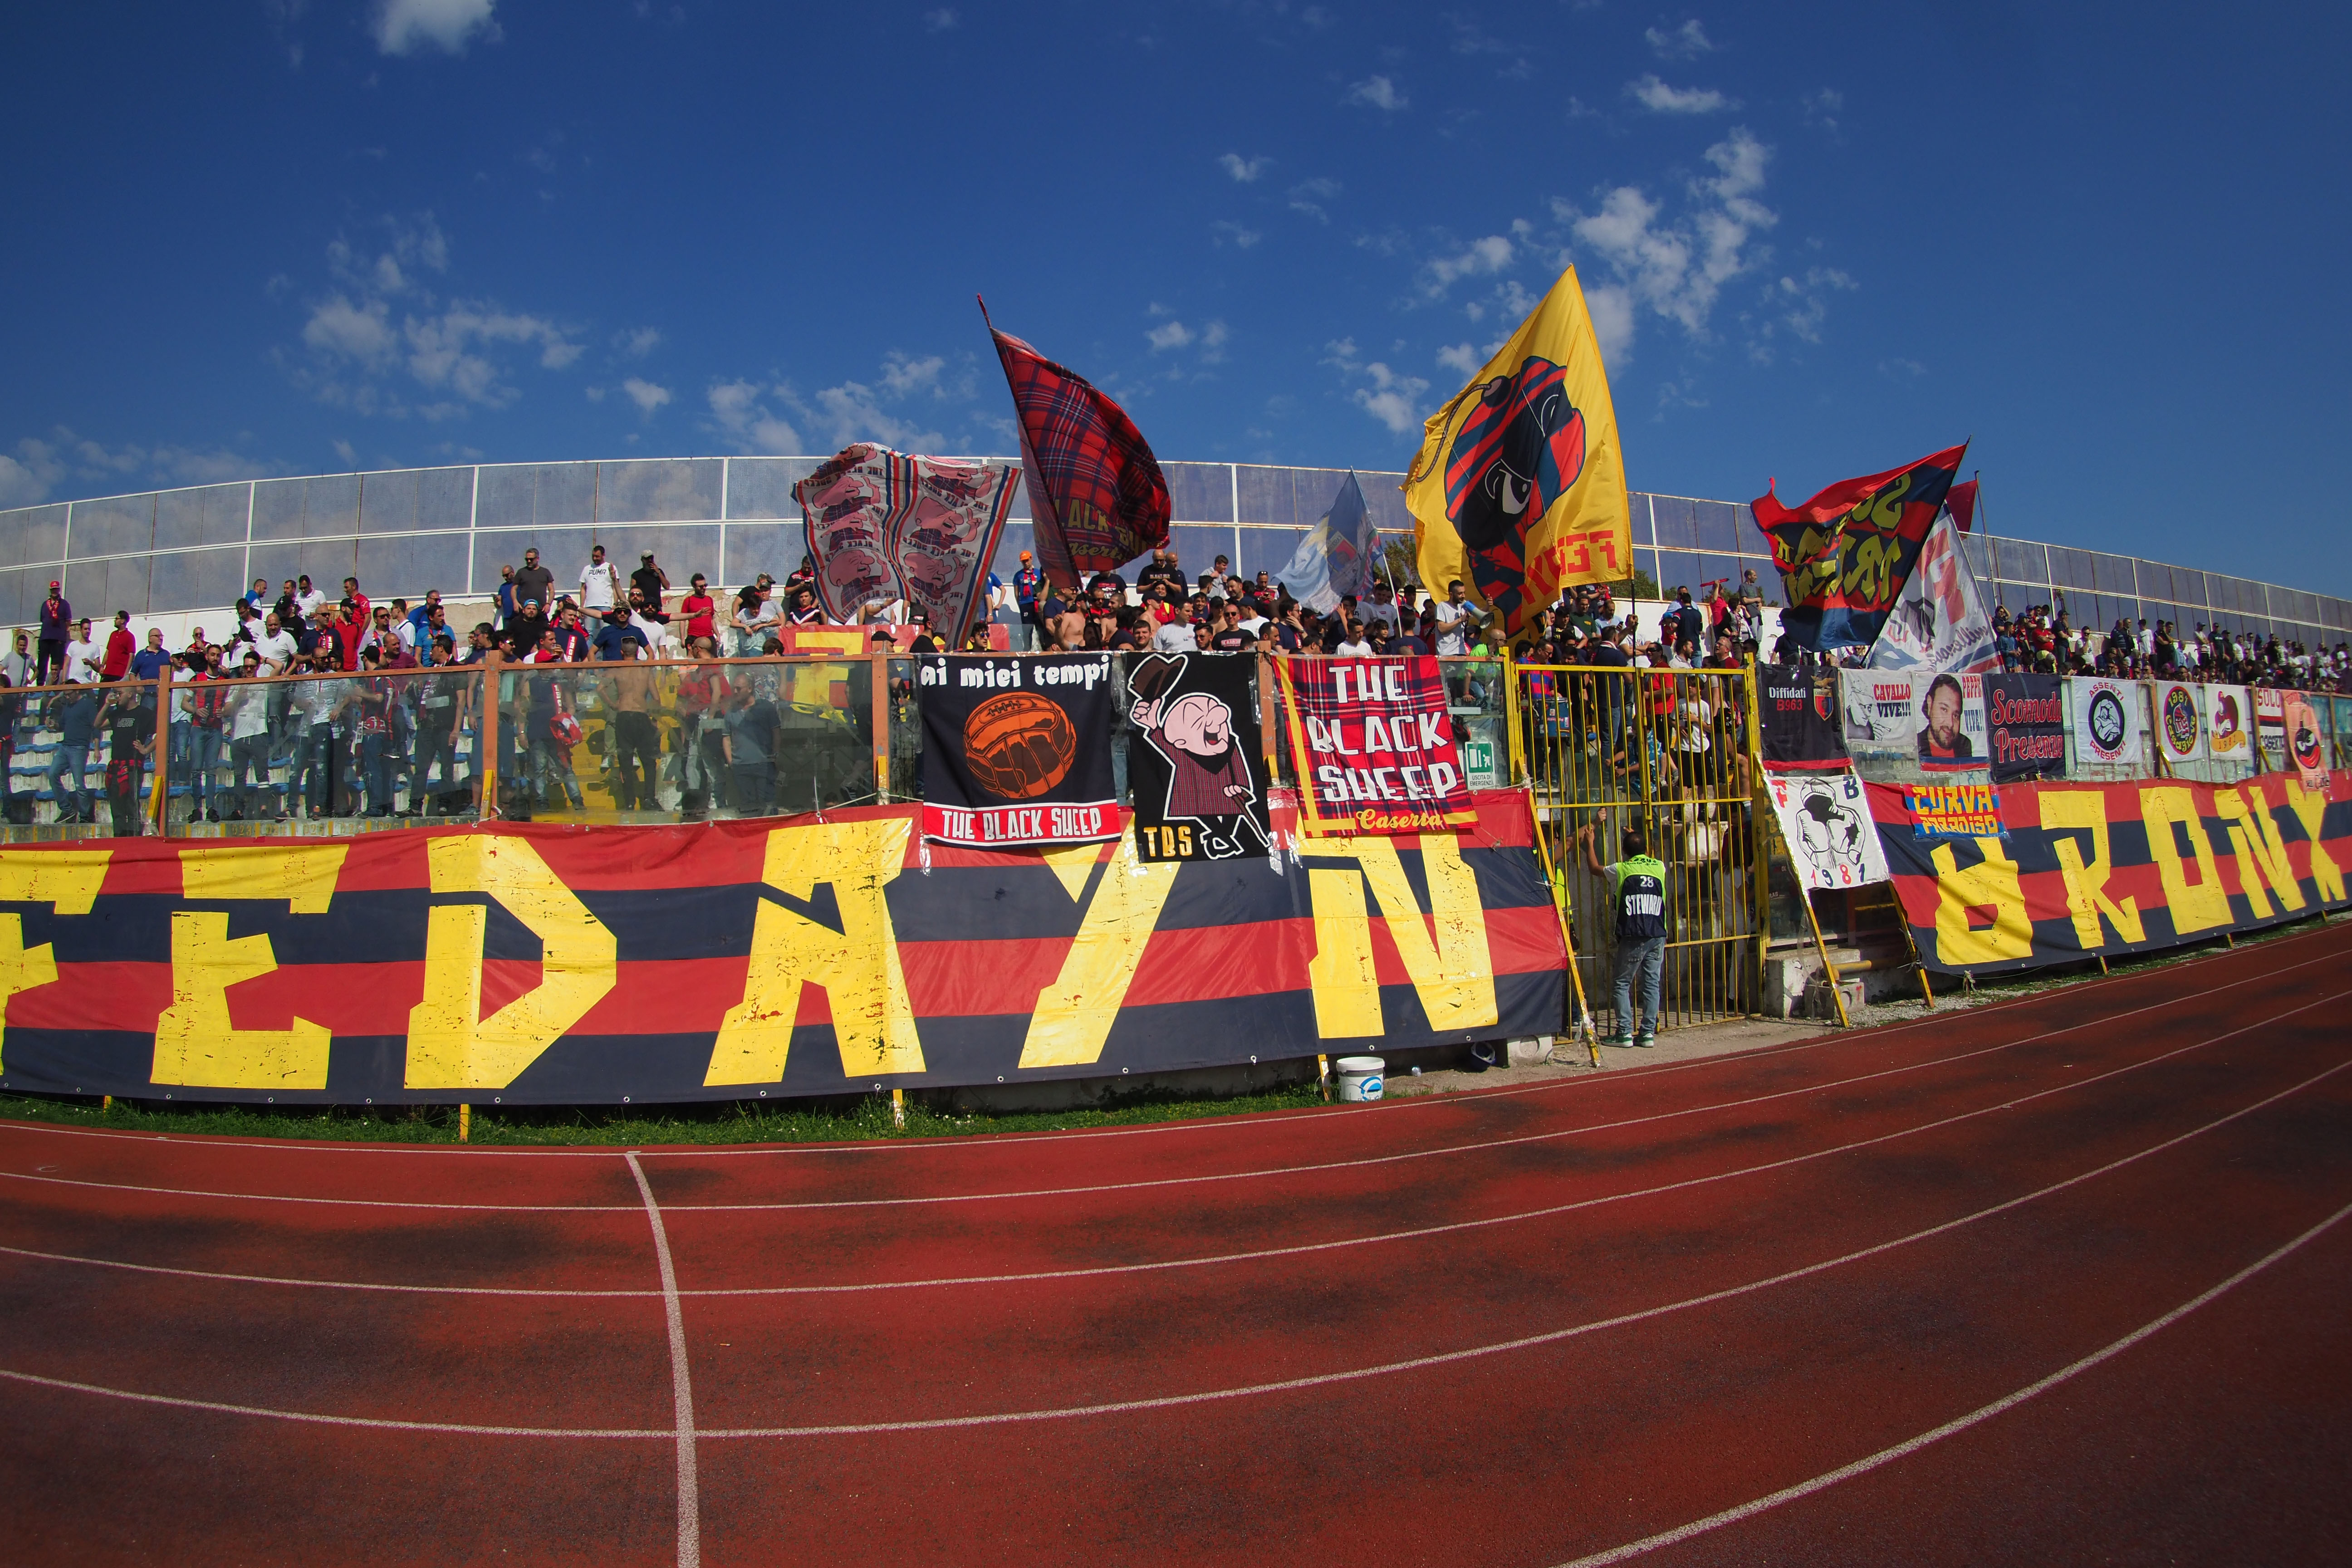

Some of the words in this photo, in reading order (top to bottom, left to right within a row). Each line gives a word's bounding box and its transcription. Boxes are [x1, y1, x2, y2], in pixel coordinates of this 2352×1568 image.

[921, 657, 947, 686] ai
[960, 660, 1021, 688] miei
[1033, 654, 1110, 691] tempi
[1329, 664, 1409, 704] THE
[1769, 686, 1807, 699] Diffidati
[1873, 683, 1911, 701] CAVALLO
[2088, 681, 2125, 702] ASSENTI
[2168, 691, 2189, 707] 1981
[2257, 689, 2281, 708] SOLO
[1777, 699, 1803, 711] B963
[1877, 701, 1911, 718] VIVE!!!
[1990, 688, 2061, 726] Scomoda
[1306, 711, 1448, 755] BLACK
[1994, 727, 2063, 764] Presenza
[2165, 714, 2196, 753] Casagiove
[2218, 734, 2237, 750] 1981
[2089, 739, 2127, 761] PRESENTI
[1318, 761, 1458, 802] SHEEP
[1771, 779, 1788, 809] F
[1842, 775, 1858, 800] B
[1912, 785, 1994, 815] CURVA
[942, 808, 976, 839] THE
[982, 808, 1043, 840] BLACK
[1051, 807, 1102, 836] SHEEP
[1356, 808, 1444, 830] Caserta
[1143, 825, 1192, 858] TBS
[1640, 876, 1654, 888] 28
[1810, 862, 1866, 887] 1981
[1930, 779, 2347, 966] BRONX
[1625, 893, 1663, 916] STEWARD
